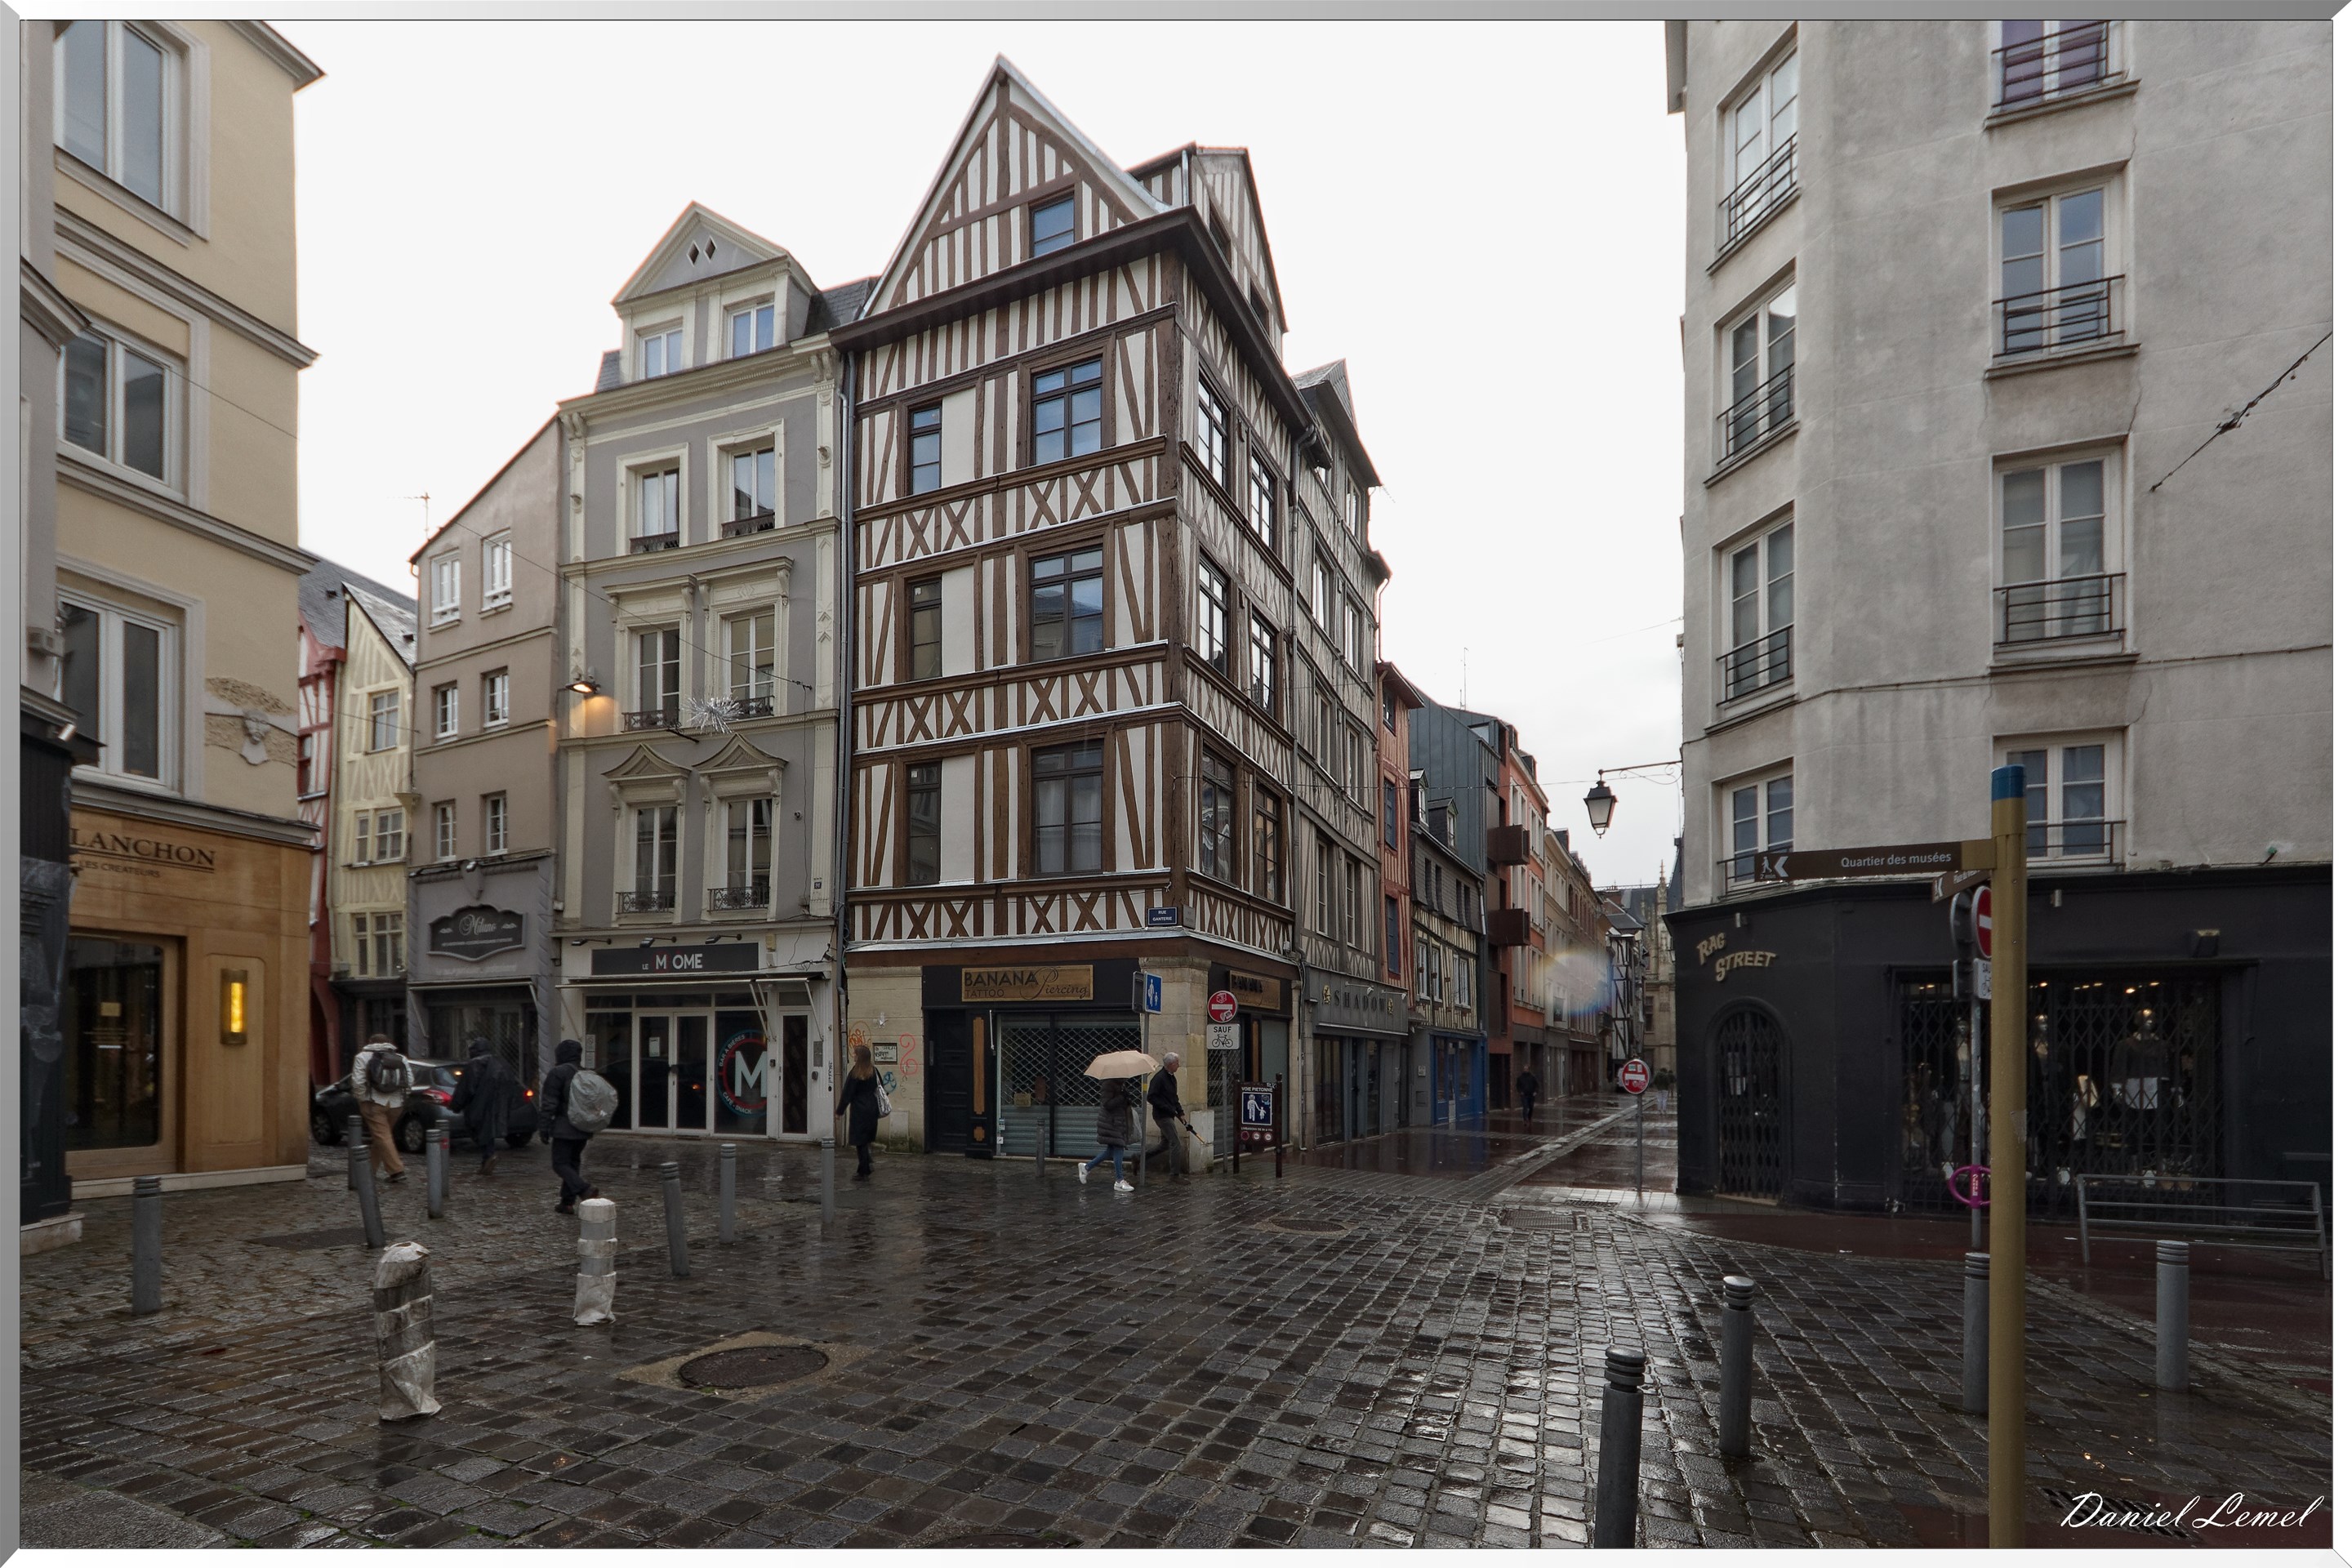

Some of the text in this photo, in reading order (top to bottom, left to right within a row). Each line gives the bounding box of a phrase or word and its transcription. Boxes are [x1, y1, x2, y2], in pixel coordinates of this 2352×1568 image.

[1841, 852, 1952, 868] Quartier des musées
[1696, 933, 1726, 966] RAG
[1715, 951, 1776, 982] STREET
[964, 966, 1089, 1000] BANANA Piercing
[965, 988, 1004, 998] TATTOO
[1334, 989, 1386, 1013] SHADOW
[735, 1050, 767, 1098] M
